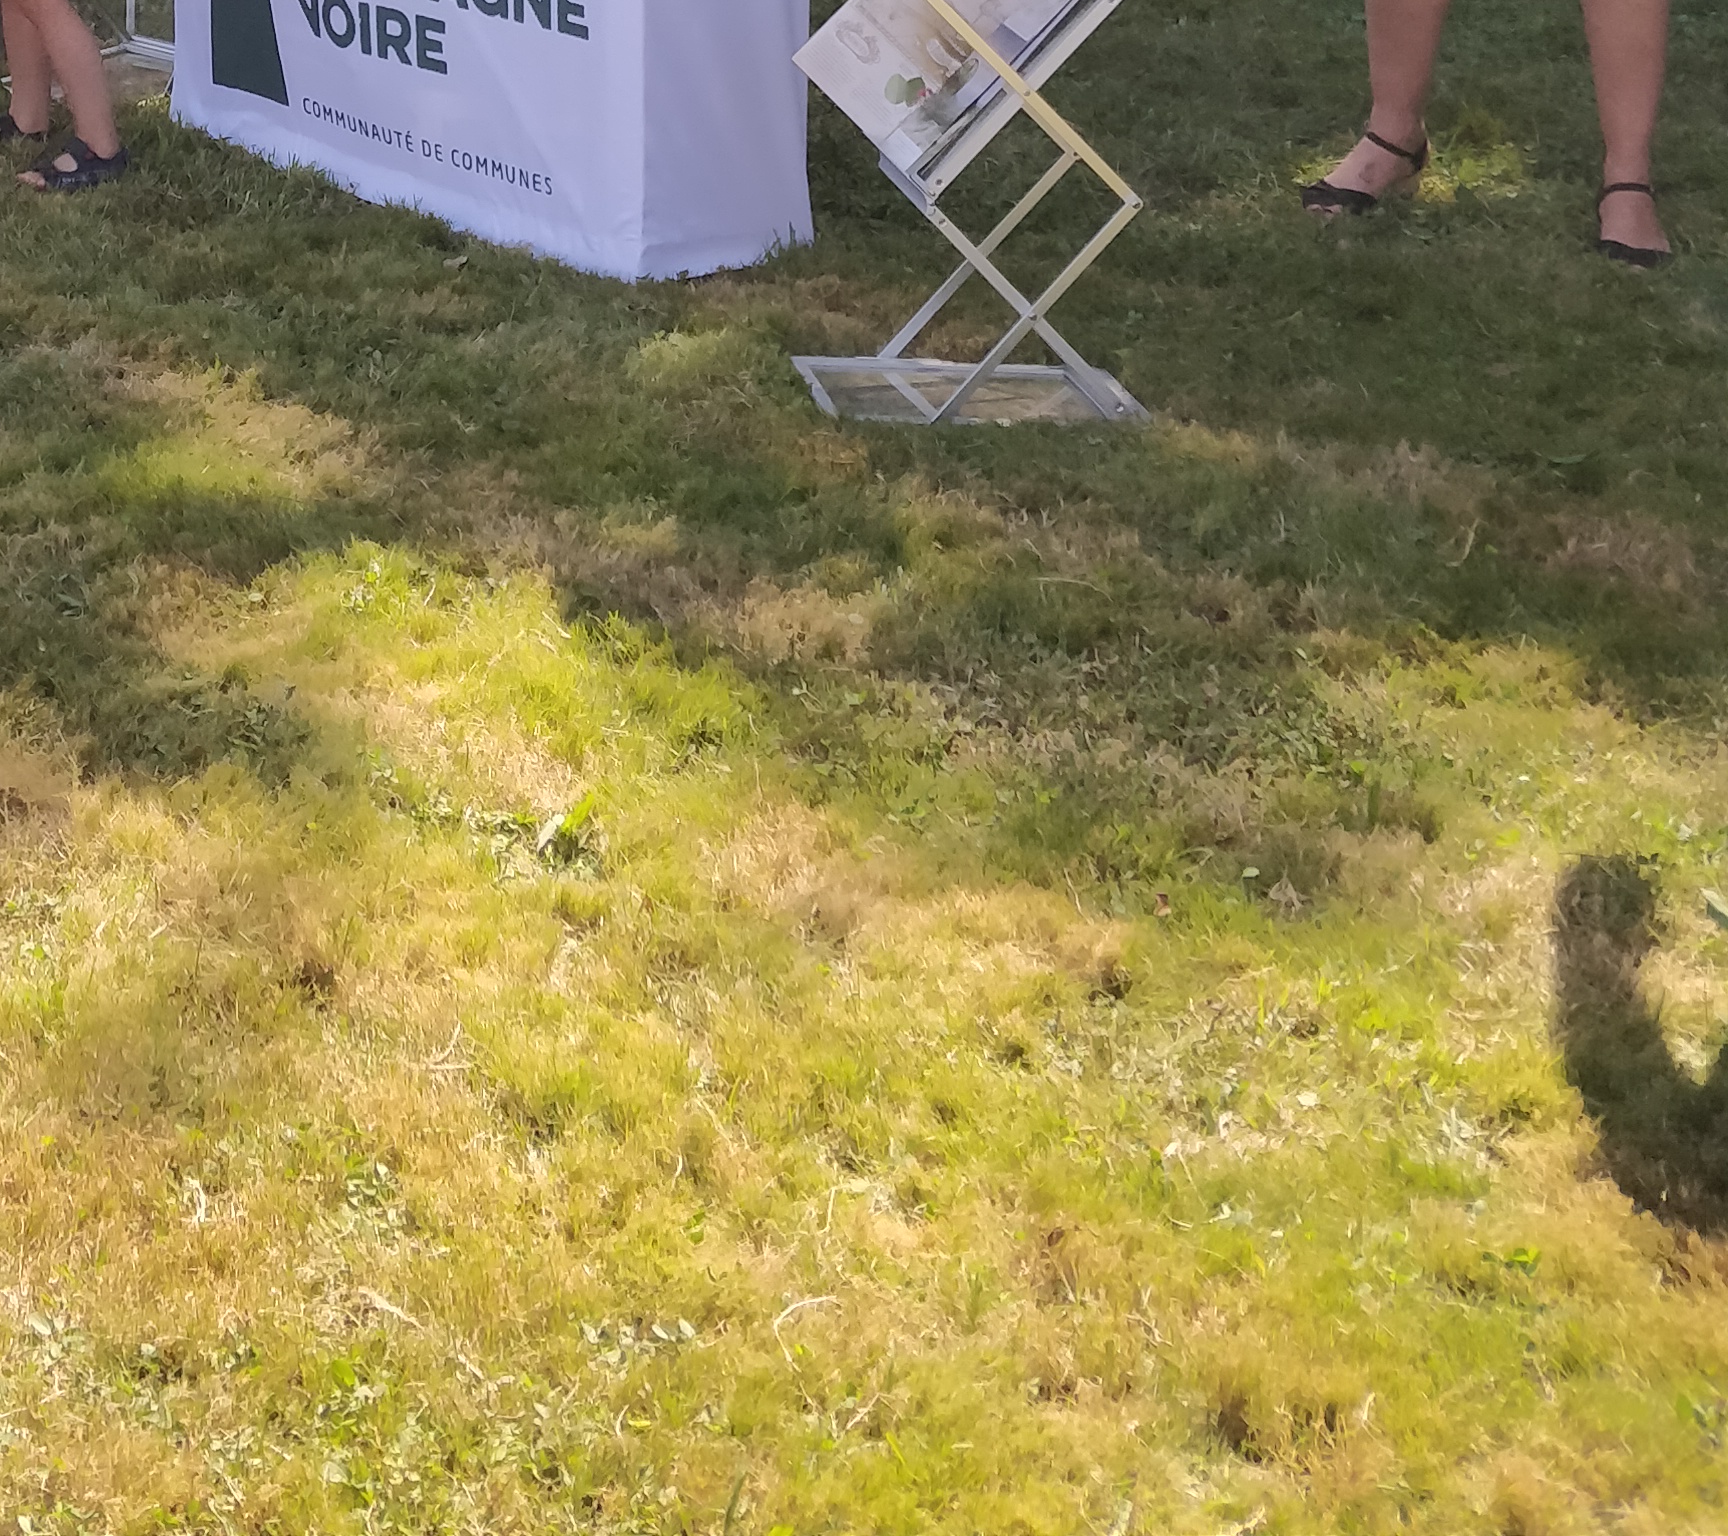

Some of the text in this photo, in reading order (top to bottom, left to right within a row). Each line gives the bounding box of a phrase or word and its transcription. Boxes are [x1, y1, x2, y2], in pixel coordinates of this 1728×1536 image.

[302, 96, 554, 196] COMMUNAUTÉ DE COMMUNES
